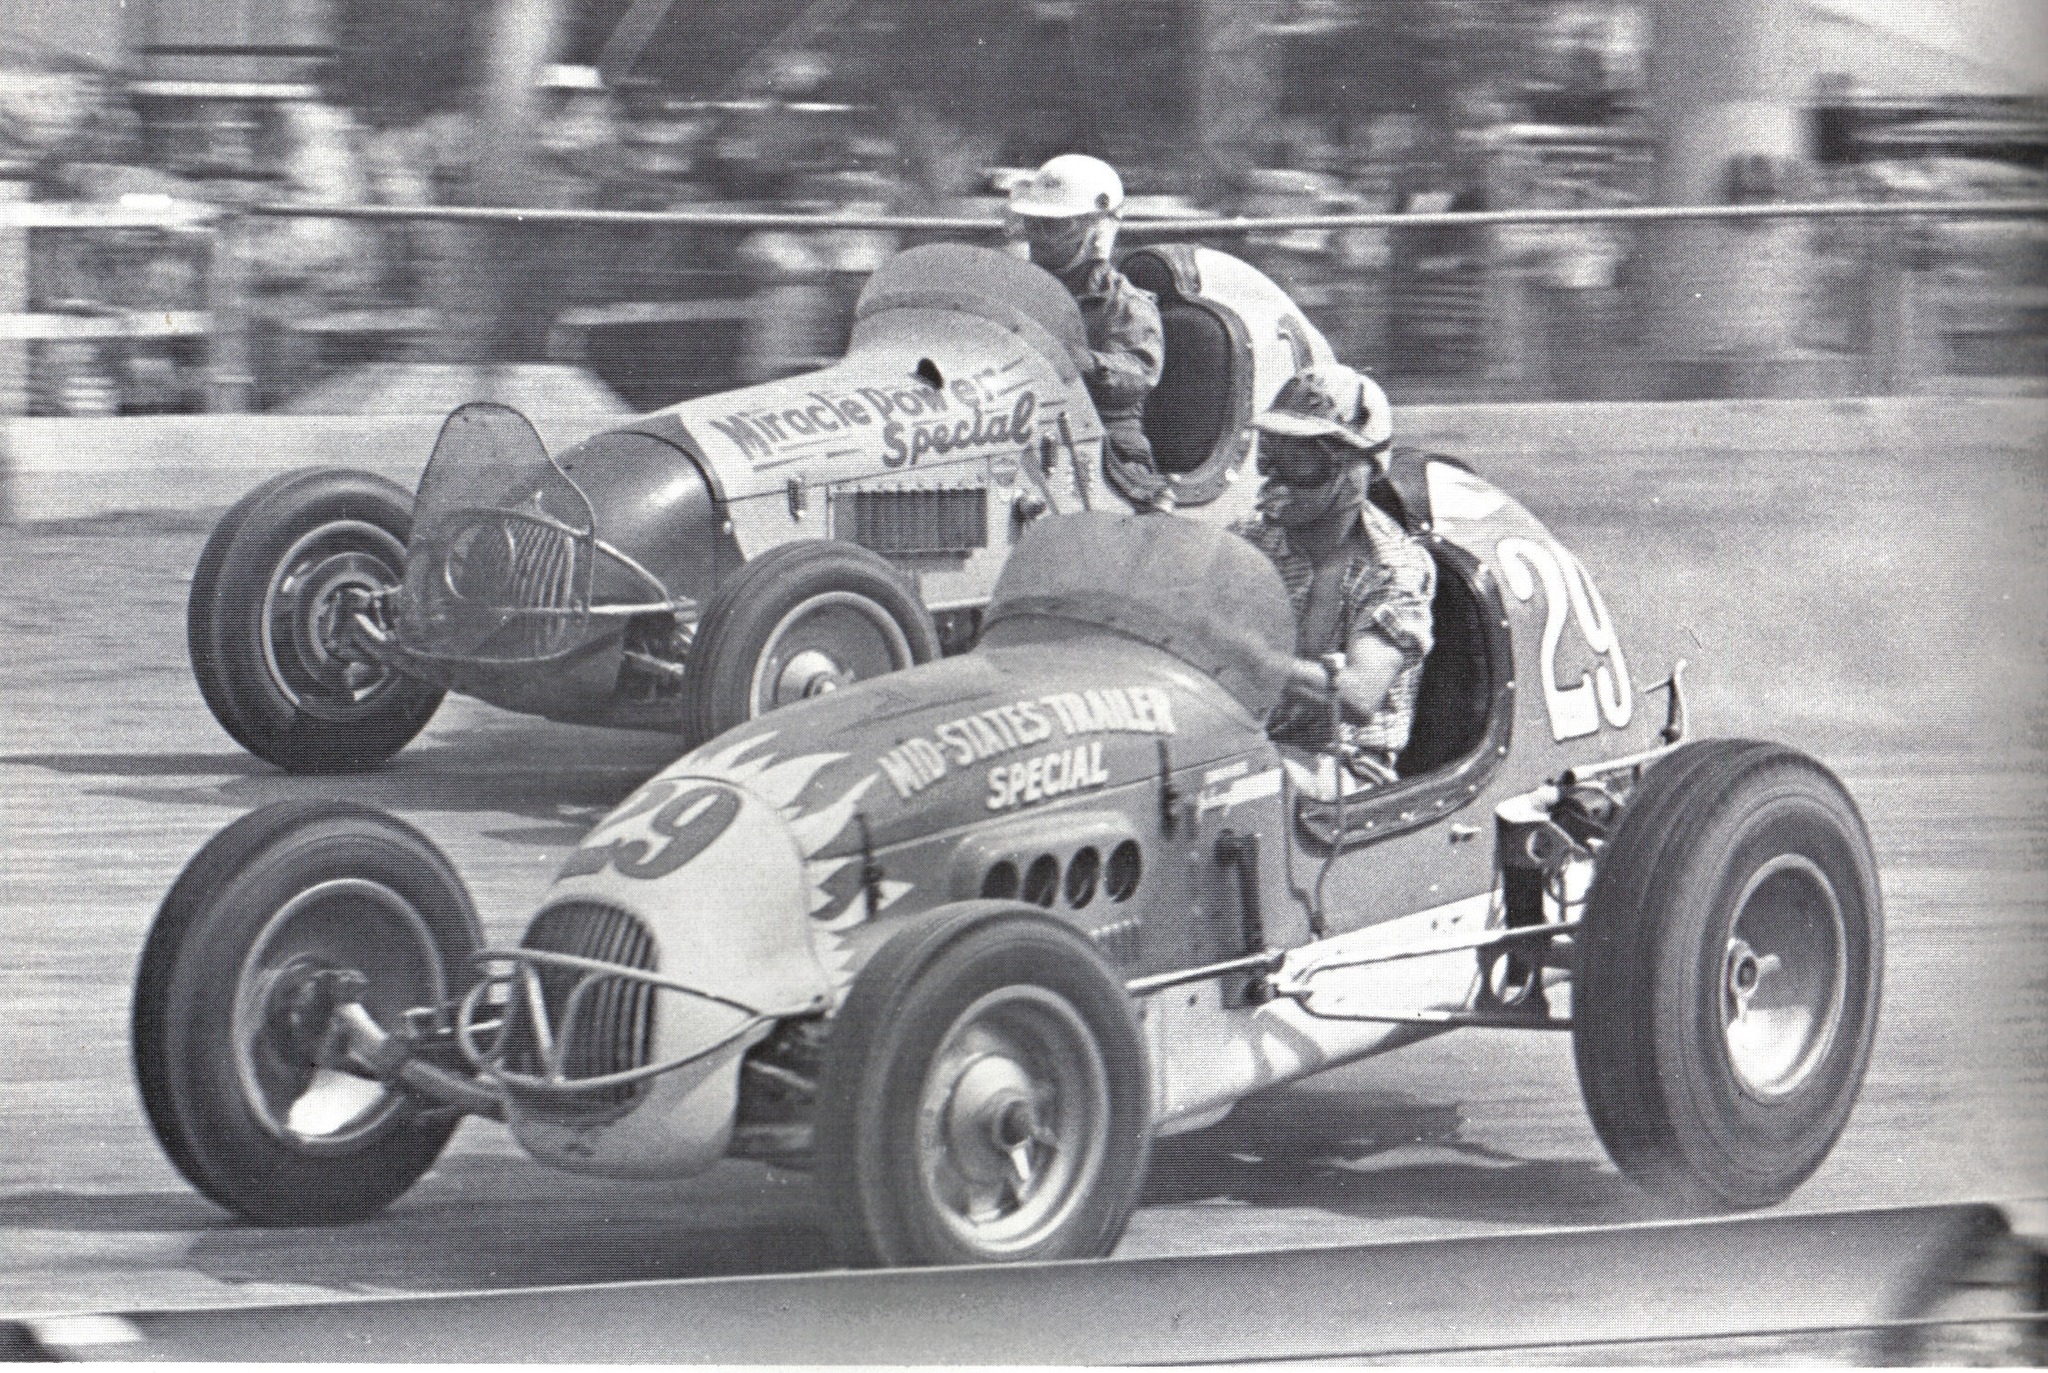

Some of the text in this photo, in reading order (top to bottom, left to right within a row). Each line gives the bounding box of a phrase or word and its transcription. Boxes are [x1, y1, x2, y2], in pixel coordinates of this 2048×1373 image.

[709, 391, 872, 461] Miracle
[881, 390, 1037, 468] Special
[1496, 537, 1632, 741] 29
[876, 686, 1177, 798] MID-STATES TRAILER
[985, 741, 1109, 810] SPECIAL
